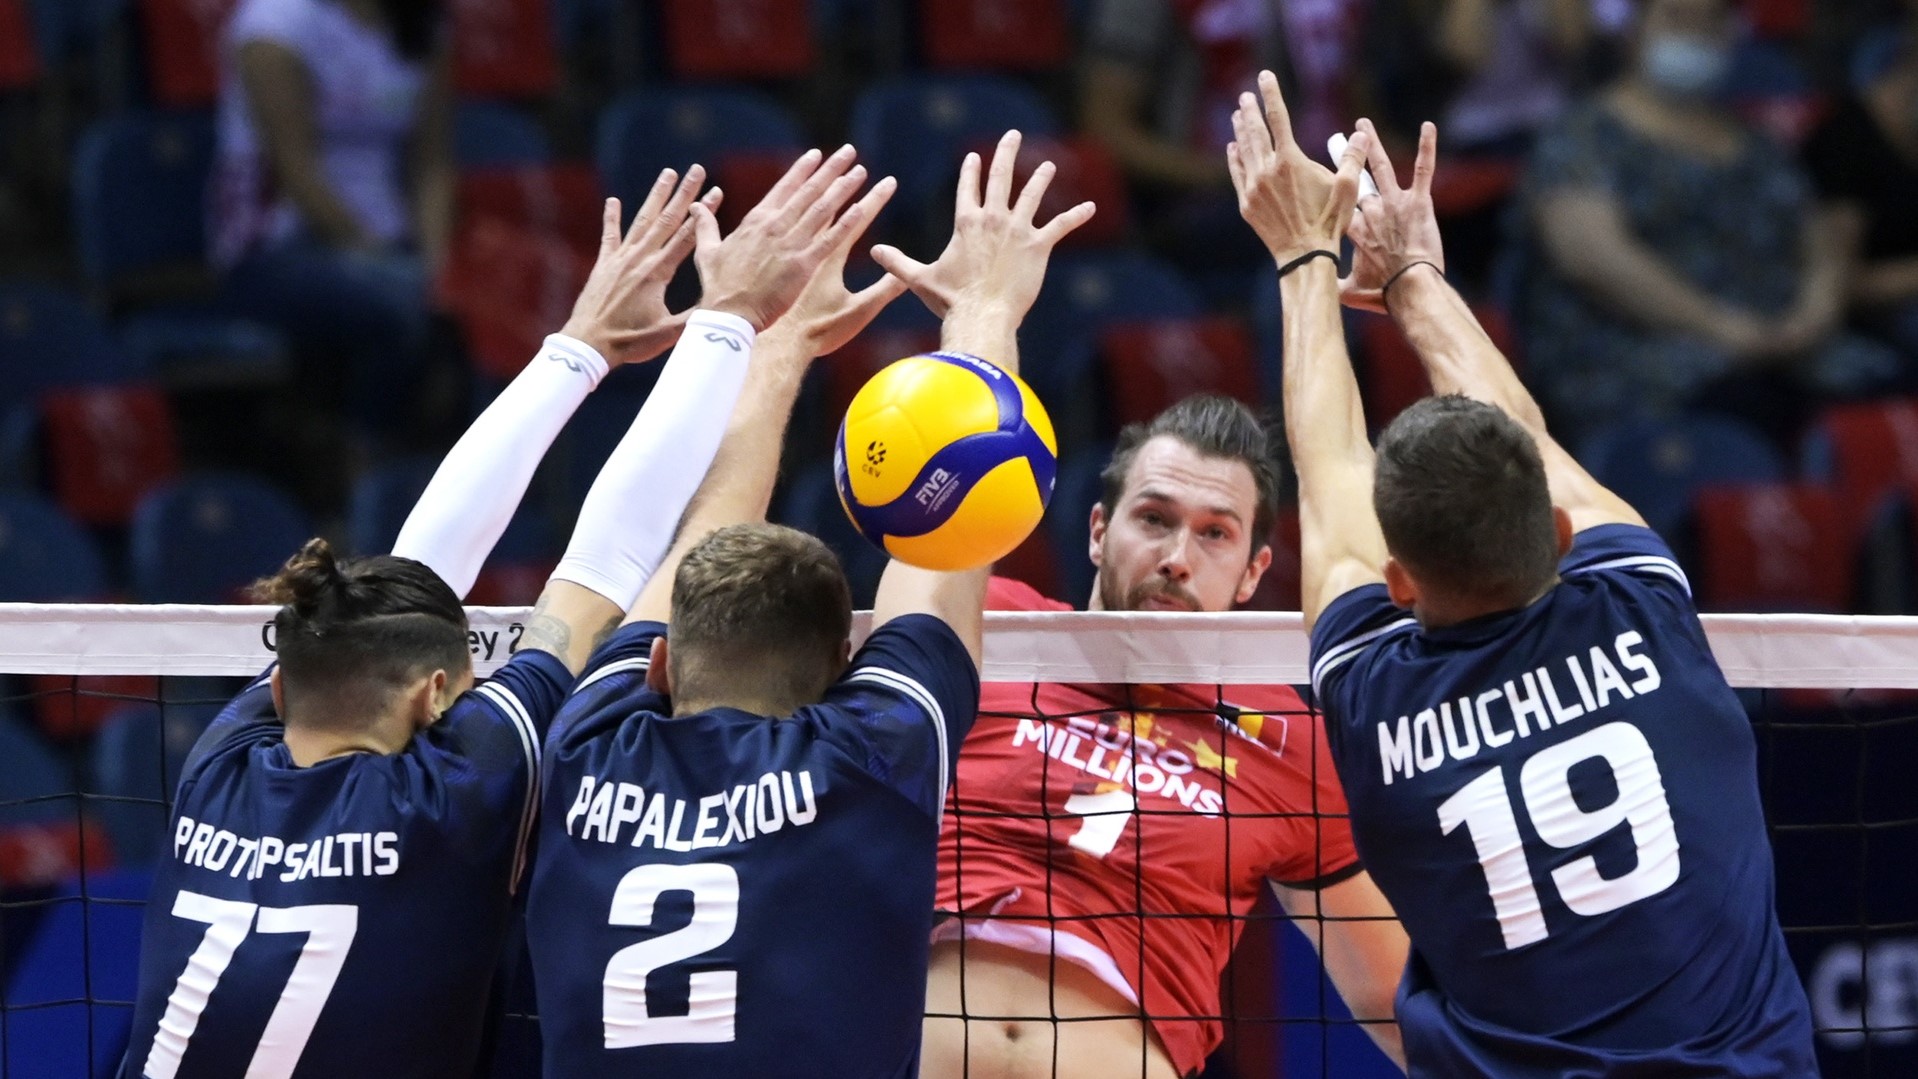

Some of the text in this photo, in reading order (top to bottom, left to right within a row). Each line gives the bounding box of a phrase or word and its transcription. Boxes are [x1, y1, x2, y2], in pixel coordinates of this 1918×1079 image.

[1012, 719, 1224, 819] MILLIONS
[1066, 716, 1194, 775] EURO
[1377, 630, 1661, 785] MOUCHLIAS
[566, 770, 818, 852] PAPALEXIOU
[1437, 721, 1681, 950] 19
[141, 890, 359, 1079] 77
[602, 863, 740, 1049] 2
